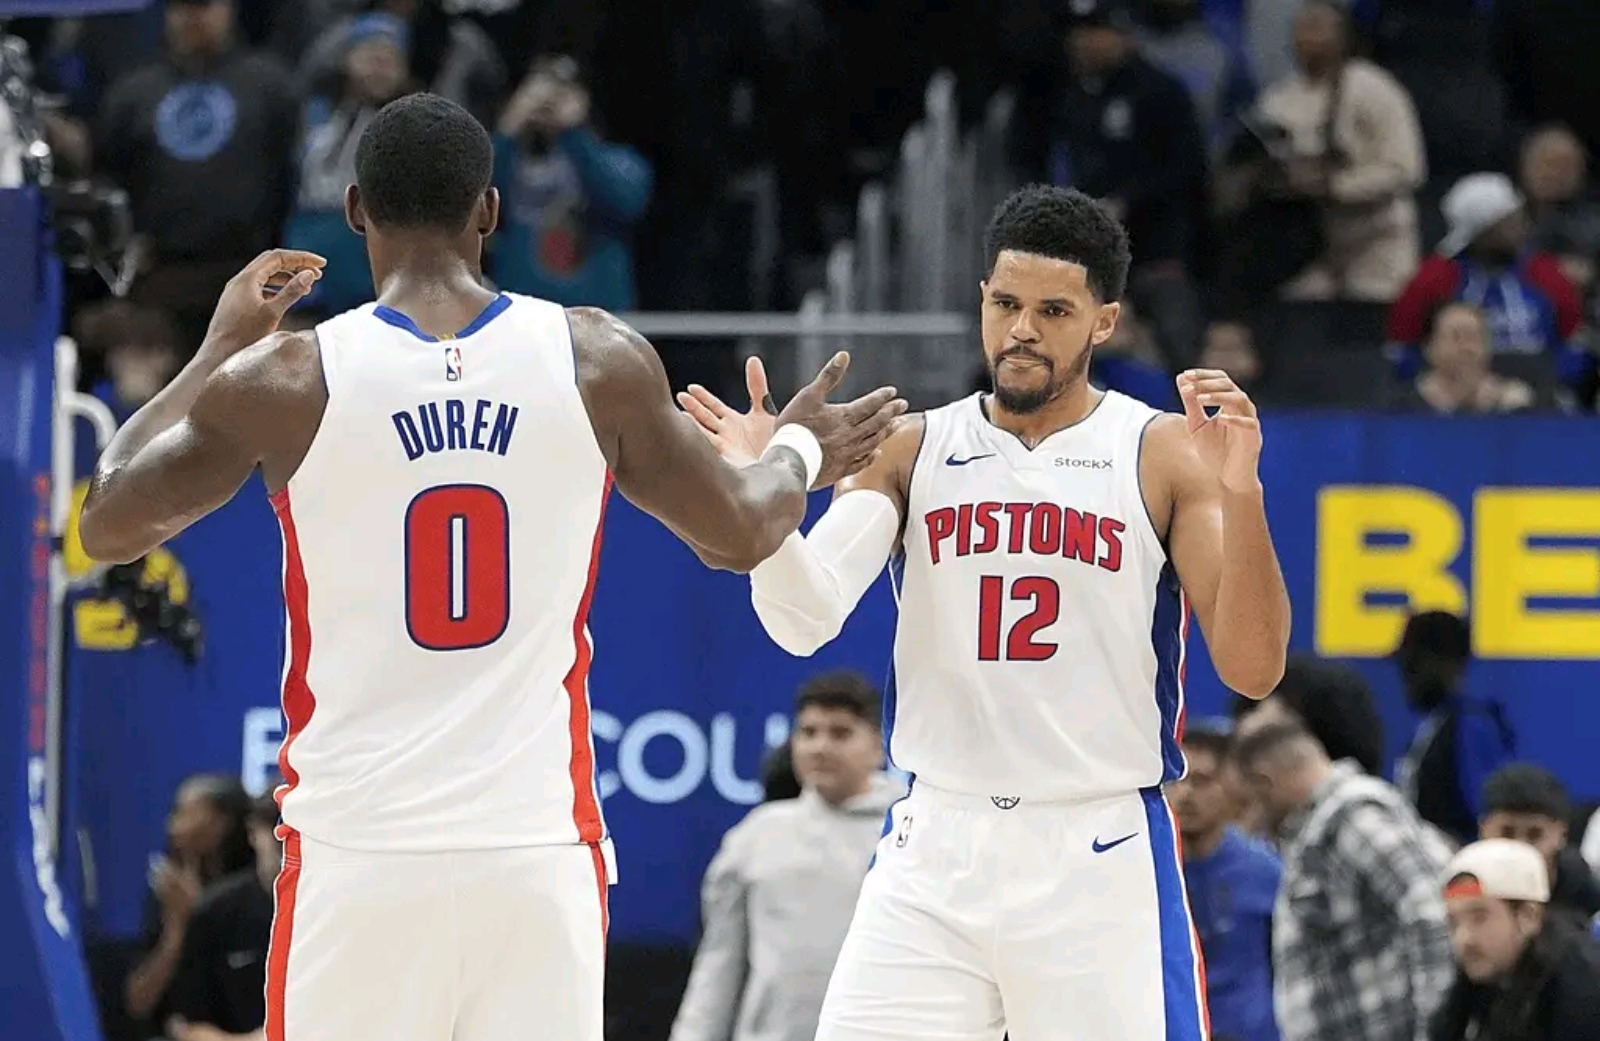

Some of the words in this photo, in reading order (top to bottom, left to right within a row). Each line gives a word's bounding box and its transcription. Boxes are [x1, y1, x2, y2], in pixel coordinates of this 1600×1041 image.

[391, 399, 519, 462] DUREN
[1054, 457, 1113, 469] StockX
[404, 484, 510, 651] 0
[925, 501, 1125, 572] PISTONS
[1315, 485, 1600, 660] BE
[978, 575, 1060, 661] 12
